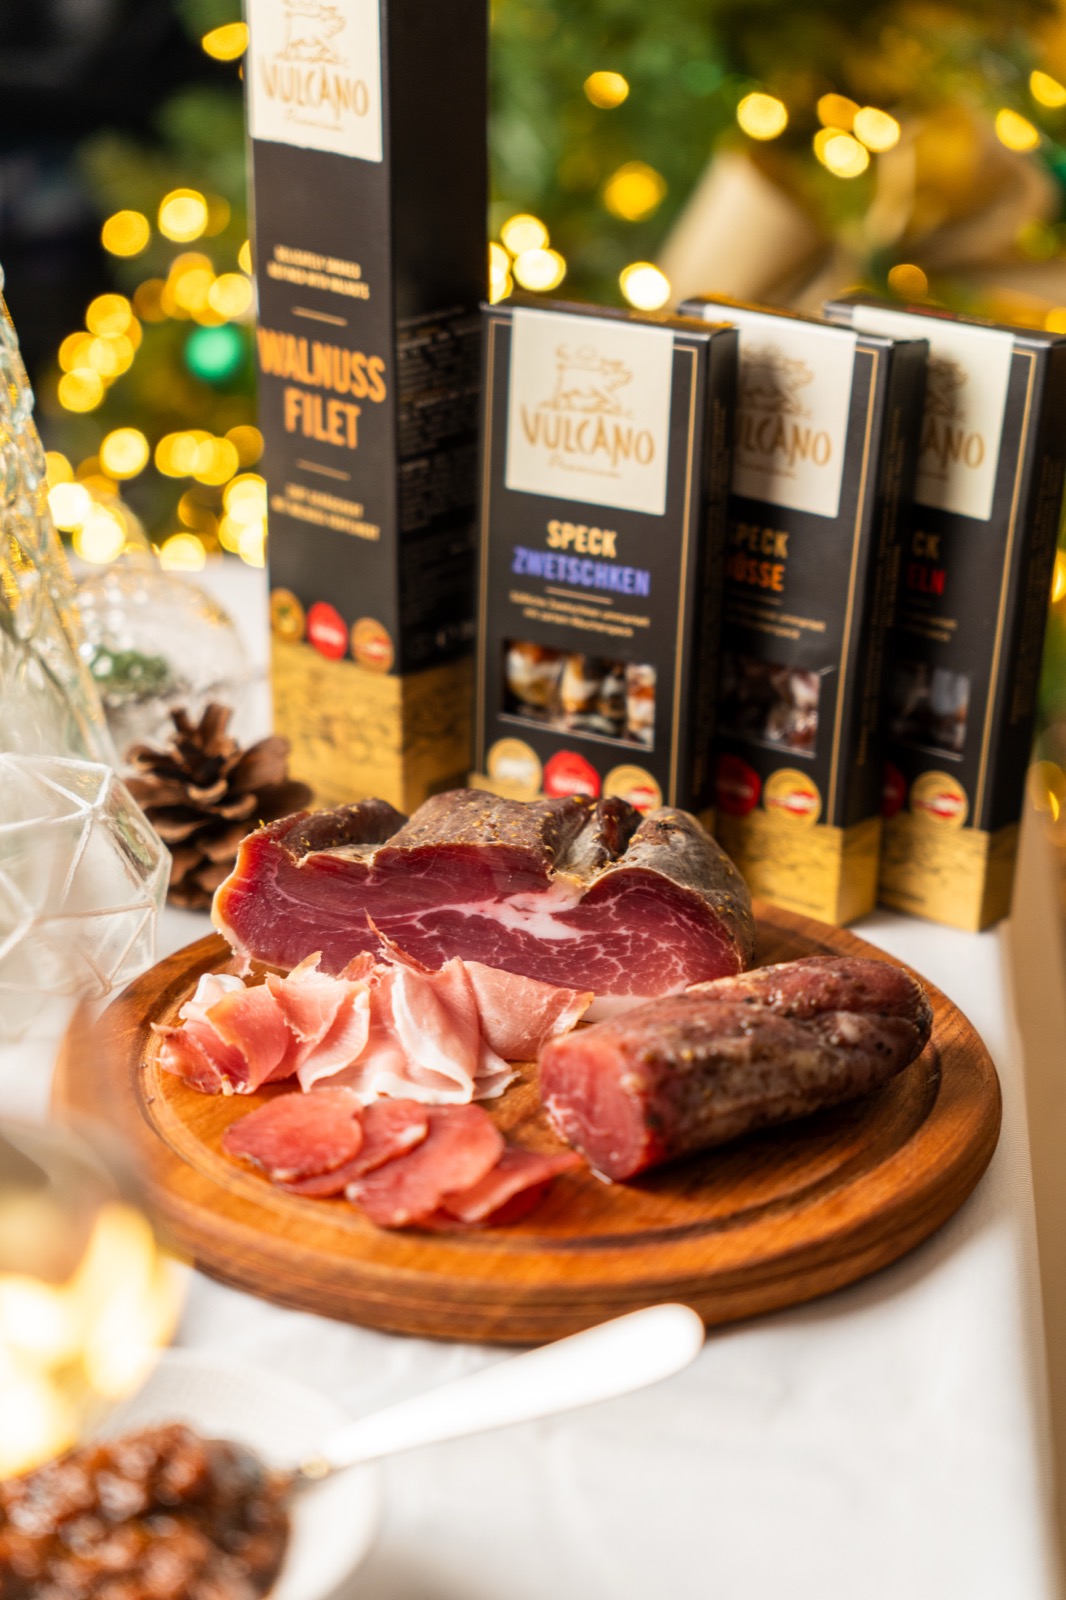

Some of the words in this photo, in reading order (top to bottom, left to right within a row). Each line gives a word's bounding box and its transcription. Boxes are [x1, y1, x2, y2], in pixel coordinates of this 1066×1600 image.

[260, 54, 370, 119] VULCANO
[257, 326, 386, 403] WALNUSS
[284, 387, 361, 449] FILET
[520, 403, 656, 468] VULCANO
[738, 412, 833, 467] LCANO
[546, 519, 617, 559] SPECK
[731, 523, 789, 560] PECK
[511, 546, 651, 597] ZWETSCHKEN
